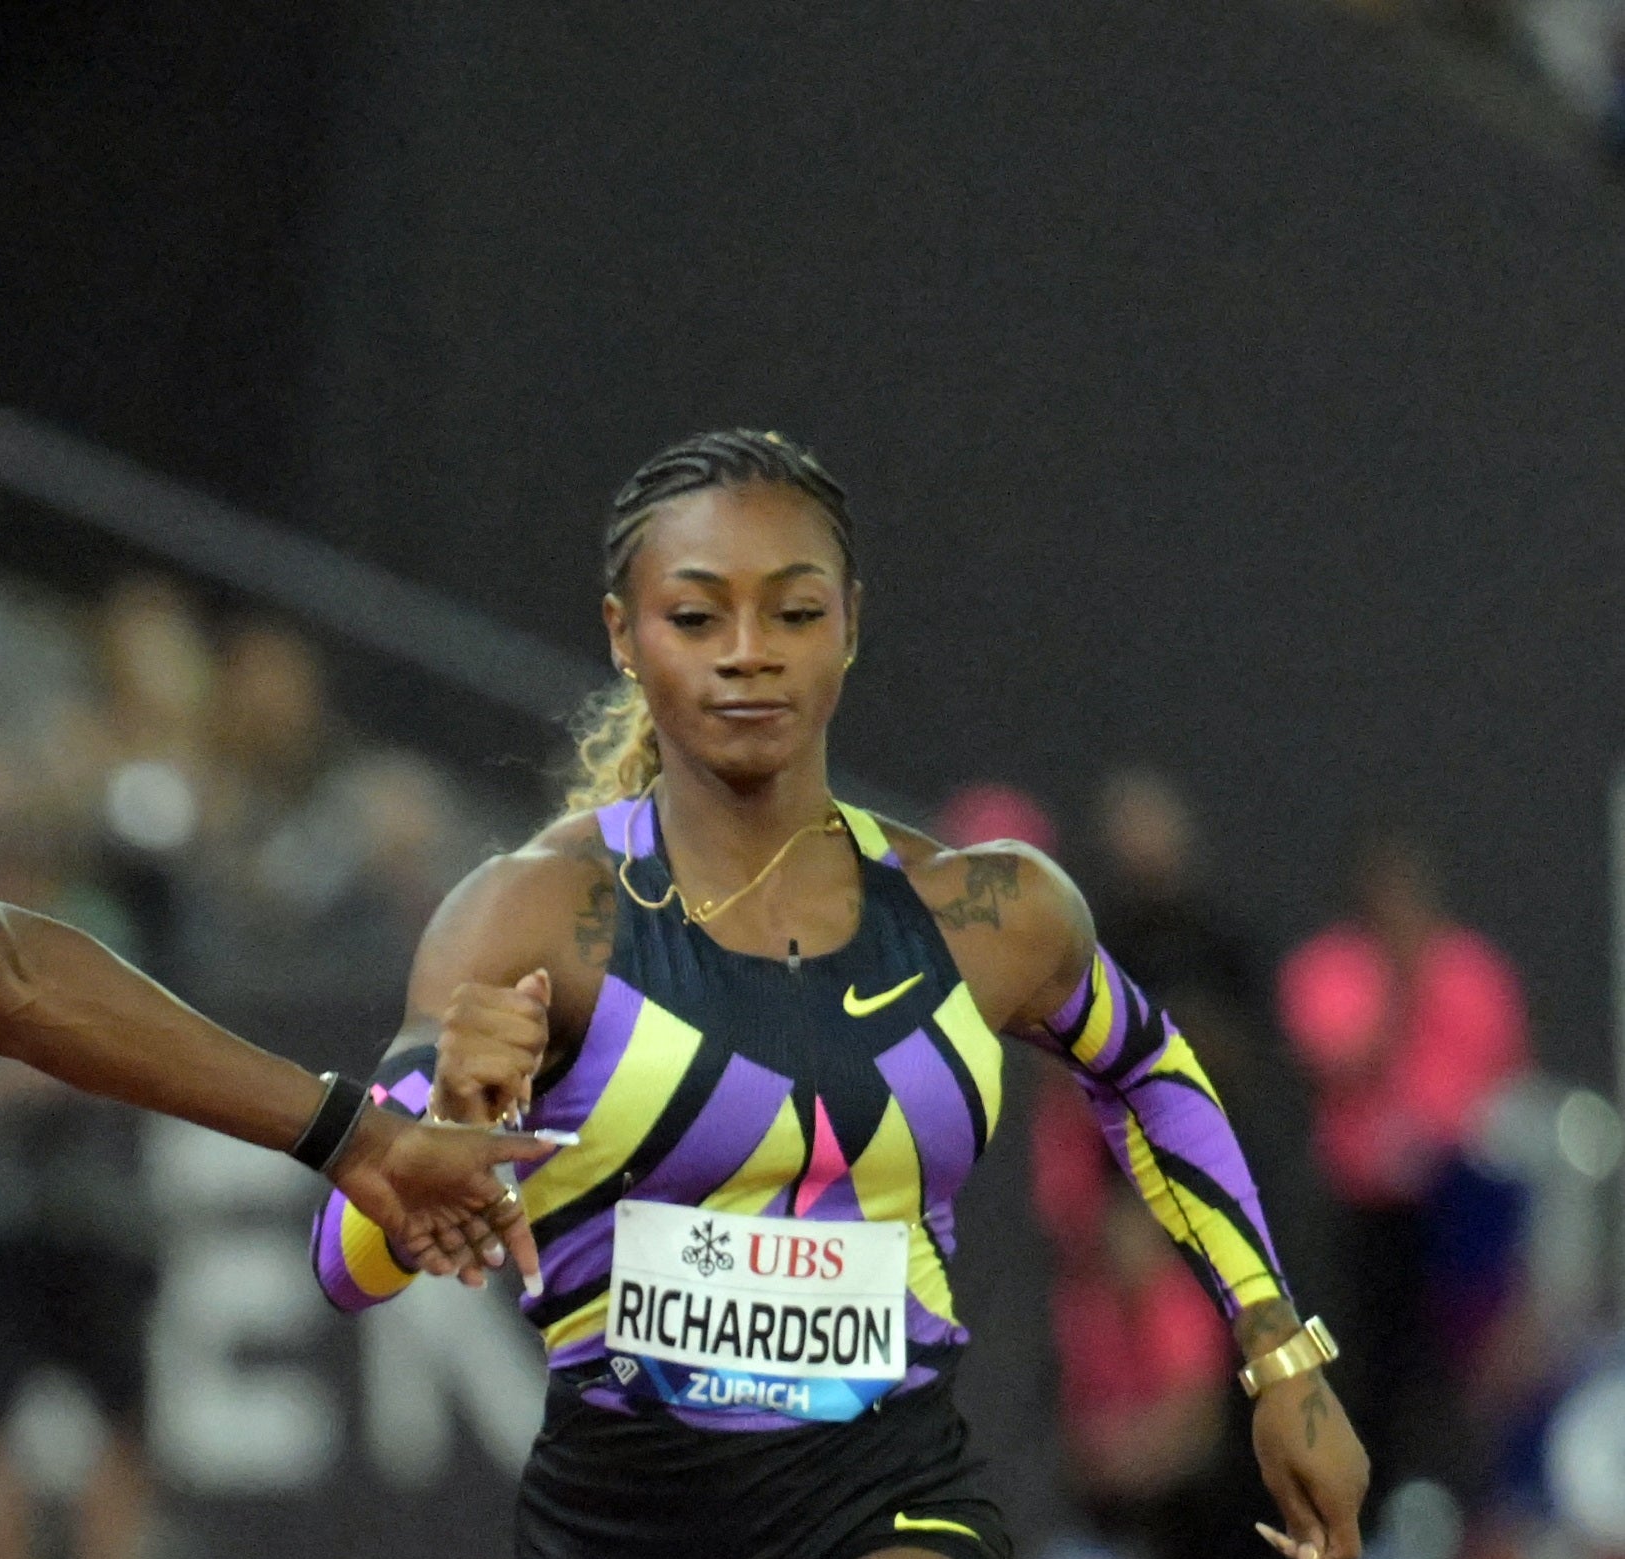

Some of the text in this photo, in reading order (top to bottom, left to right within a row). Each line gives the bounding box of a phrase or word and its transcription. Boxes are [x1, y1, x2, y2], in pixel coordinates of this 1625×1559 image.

[747, 1232, 845, 1280] UBS
[615, 1279, 892, 1367] RICHARDSON
[686, 1372, 811, 1413] ZURICH
